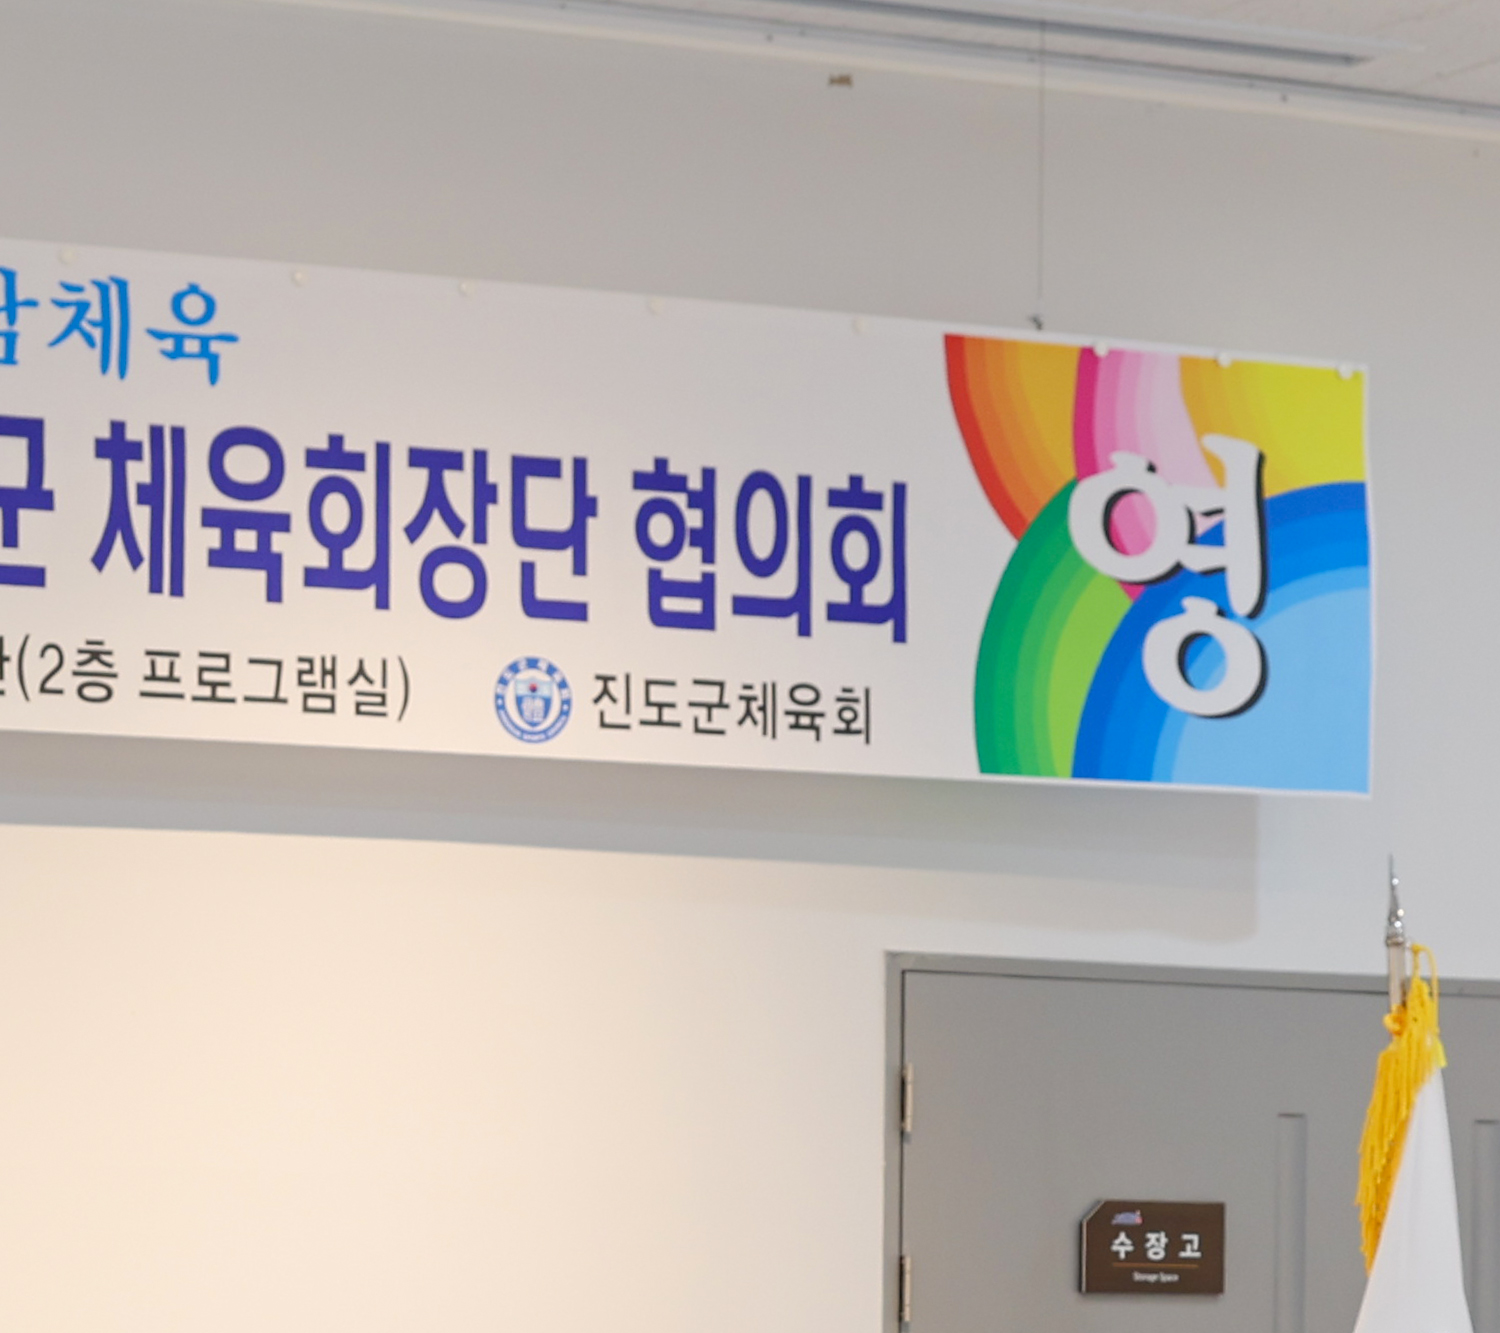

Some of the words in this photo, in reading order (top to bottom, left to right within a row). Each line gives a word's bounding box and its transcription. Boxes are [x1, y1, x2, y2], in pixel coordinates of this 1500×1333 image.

[93, 421, 597, 621] 체육회장단
[634, 458, 907, 643] 협의회
[1068, 433, 1268, 719] 영
[140, 650, 411, 721] 프로그램실)
[593, 673, 870, 745] 진도군체육회
